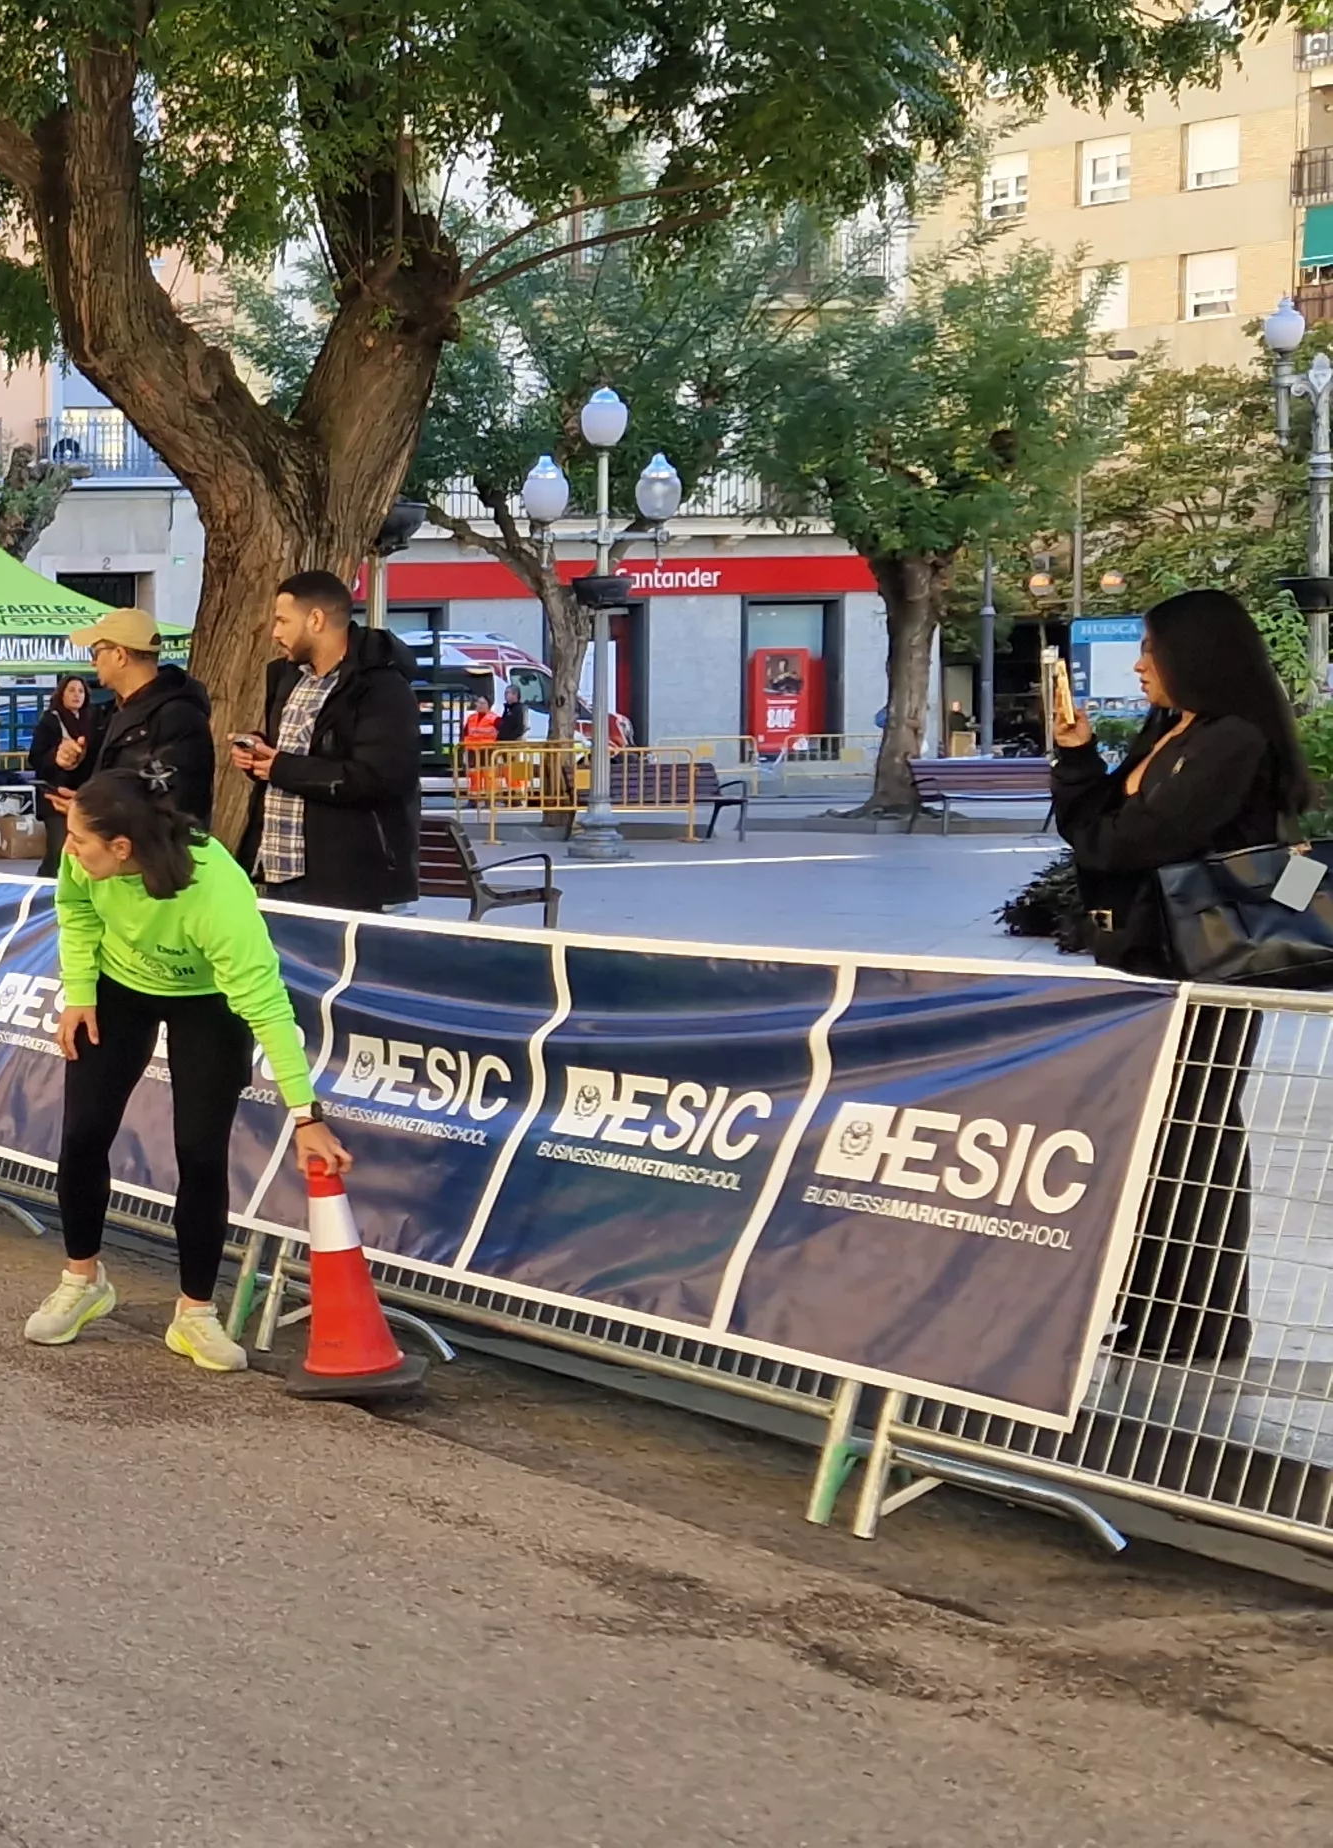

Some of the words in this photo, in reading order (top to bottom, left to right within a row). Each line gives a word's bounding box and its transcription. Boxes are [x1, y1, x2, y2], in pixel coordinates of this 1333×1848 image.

[101, 557, 111, 570] 2
[11, 975, 68, 1034] ES
[380, 1041, 512, 1121] ESIC
[602, 1072, 773, 1161] ESIC
[879, 1108, 1095, 1214] ESIC
